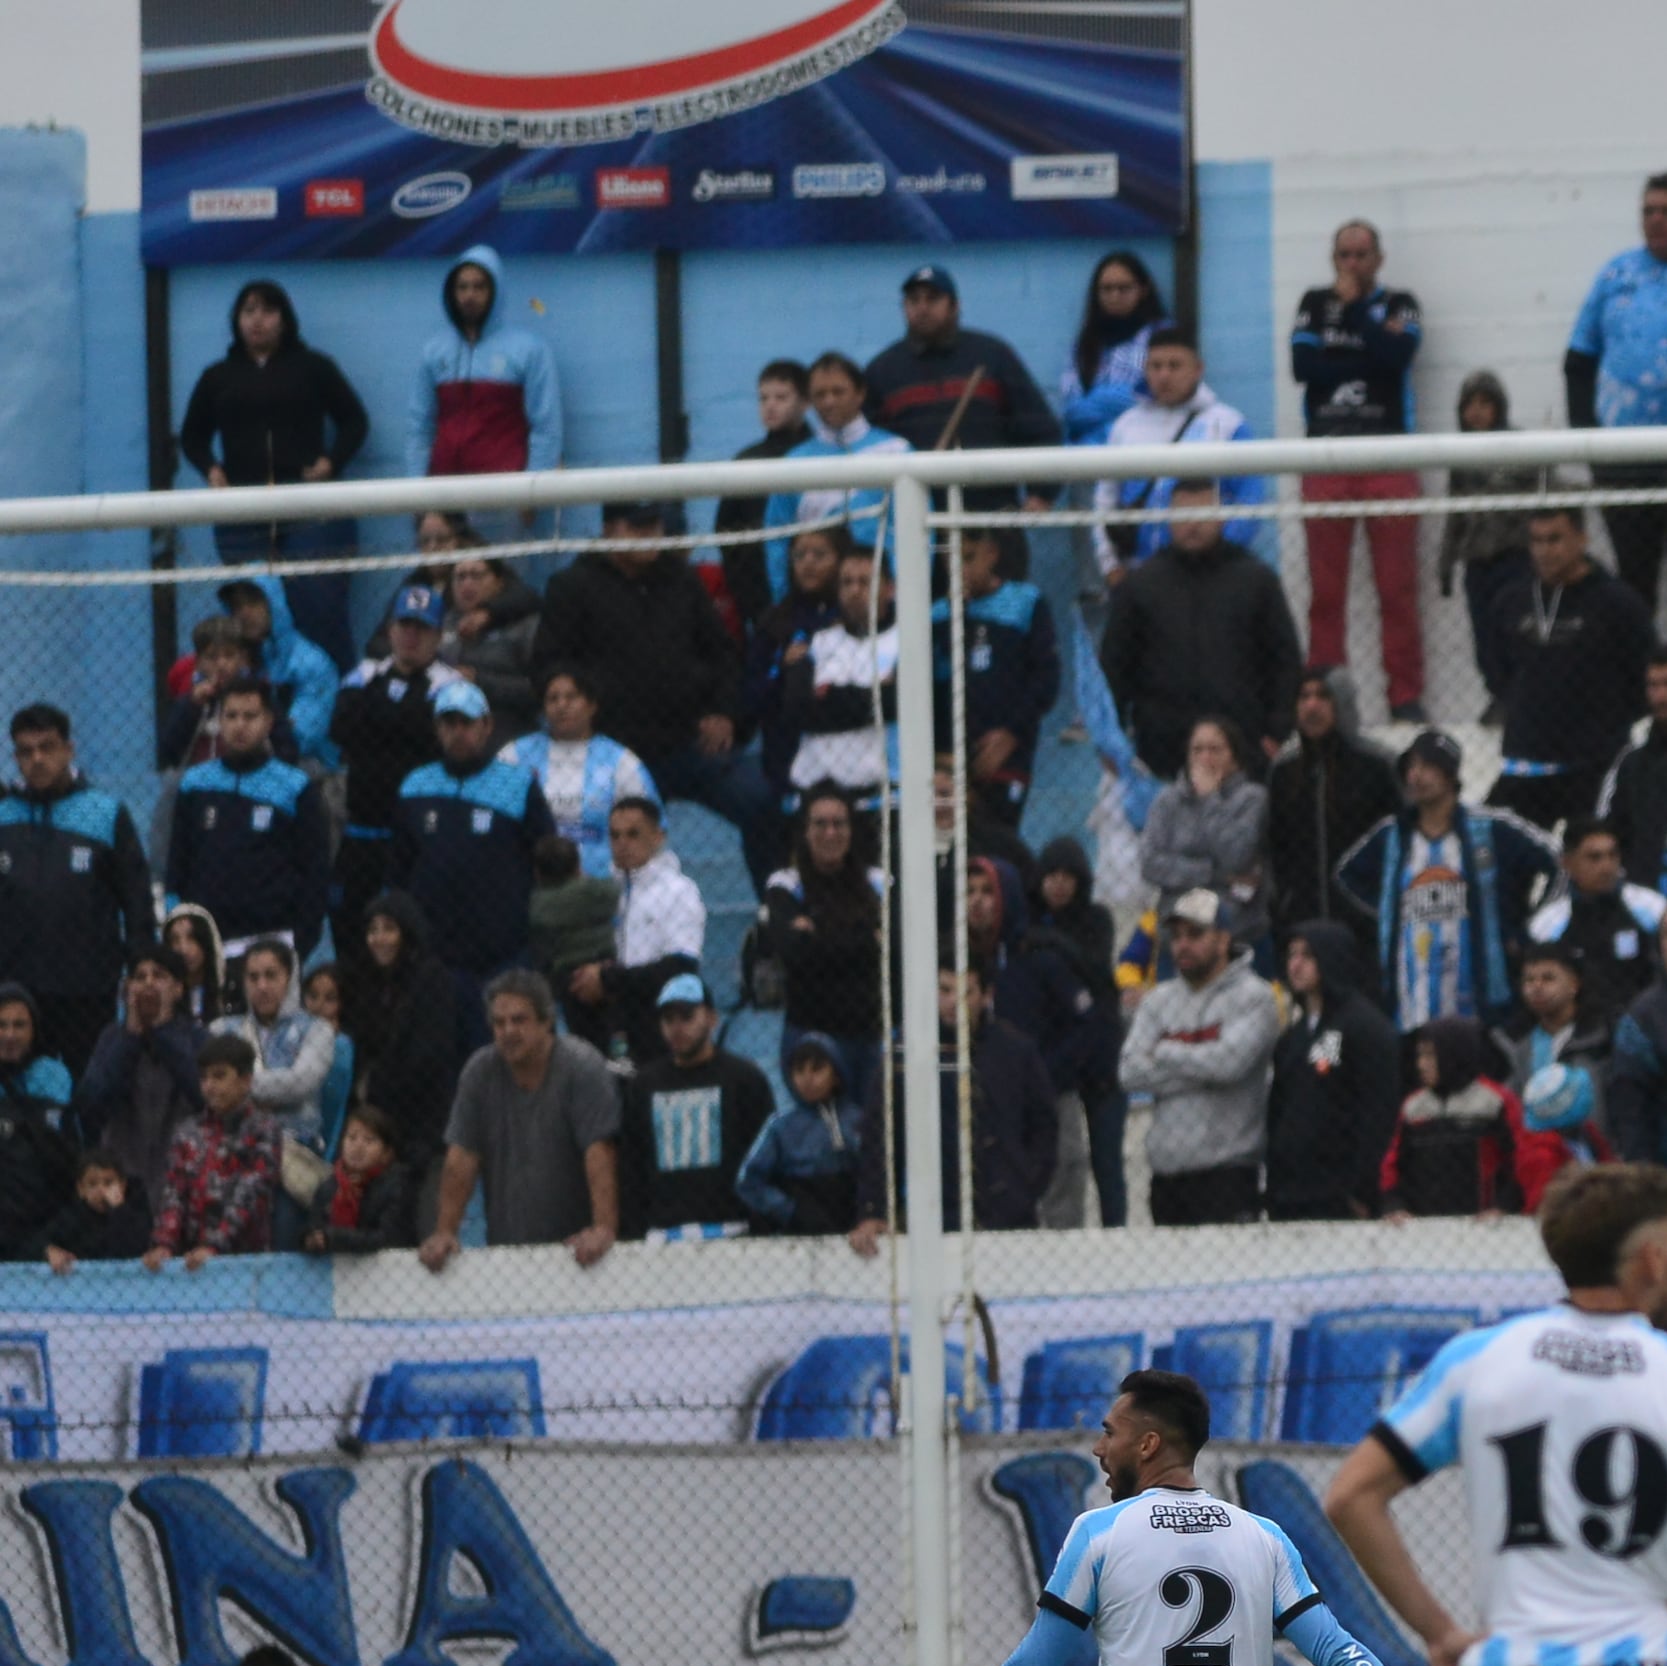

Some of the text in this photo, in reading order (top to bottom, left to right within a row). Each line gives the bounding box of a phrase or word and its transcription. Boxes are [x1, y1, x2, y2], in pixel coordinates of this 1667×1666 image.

[520, 109, 637, 145] MUEBLES
[1151, 1504, 1225, 1517] BROSAS
[1150, 1513, 1232, 1530] FRESCAS
